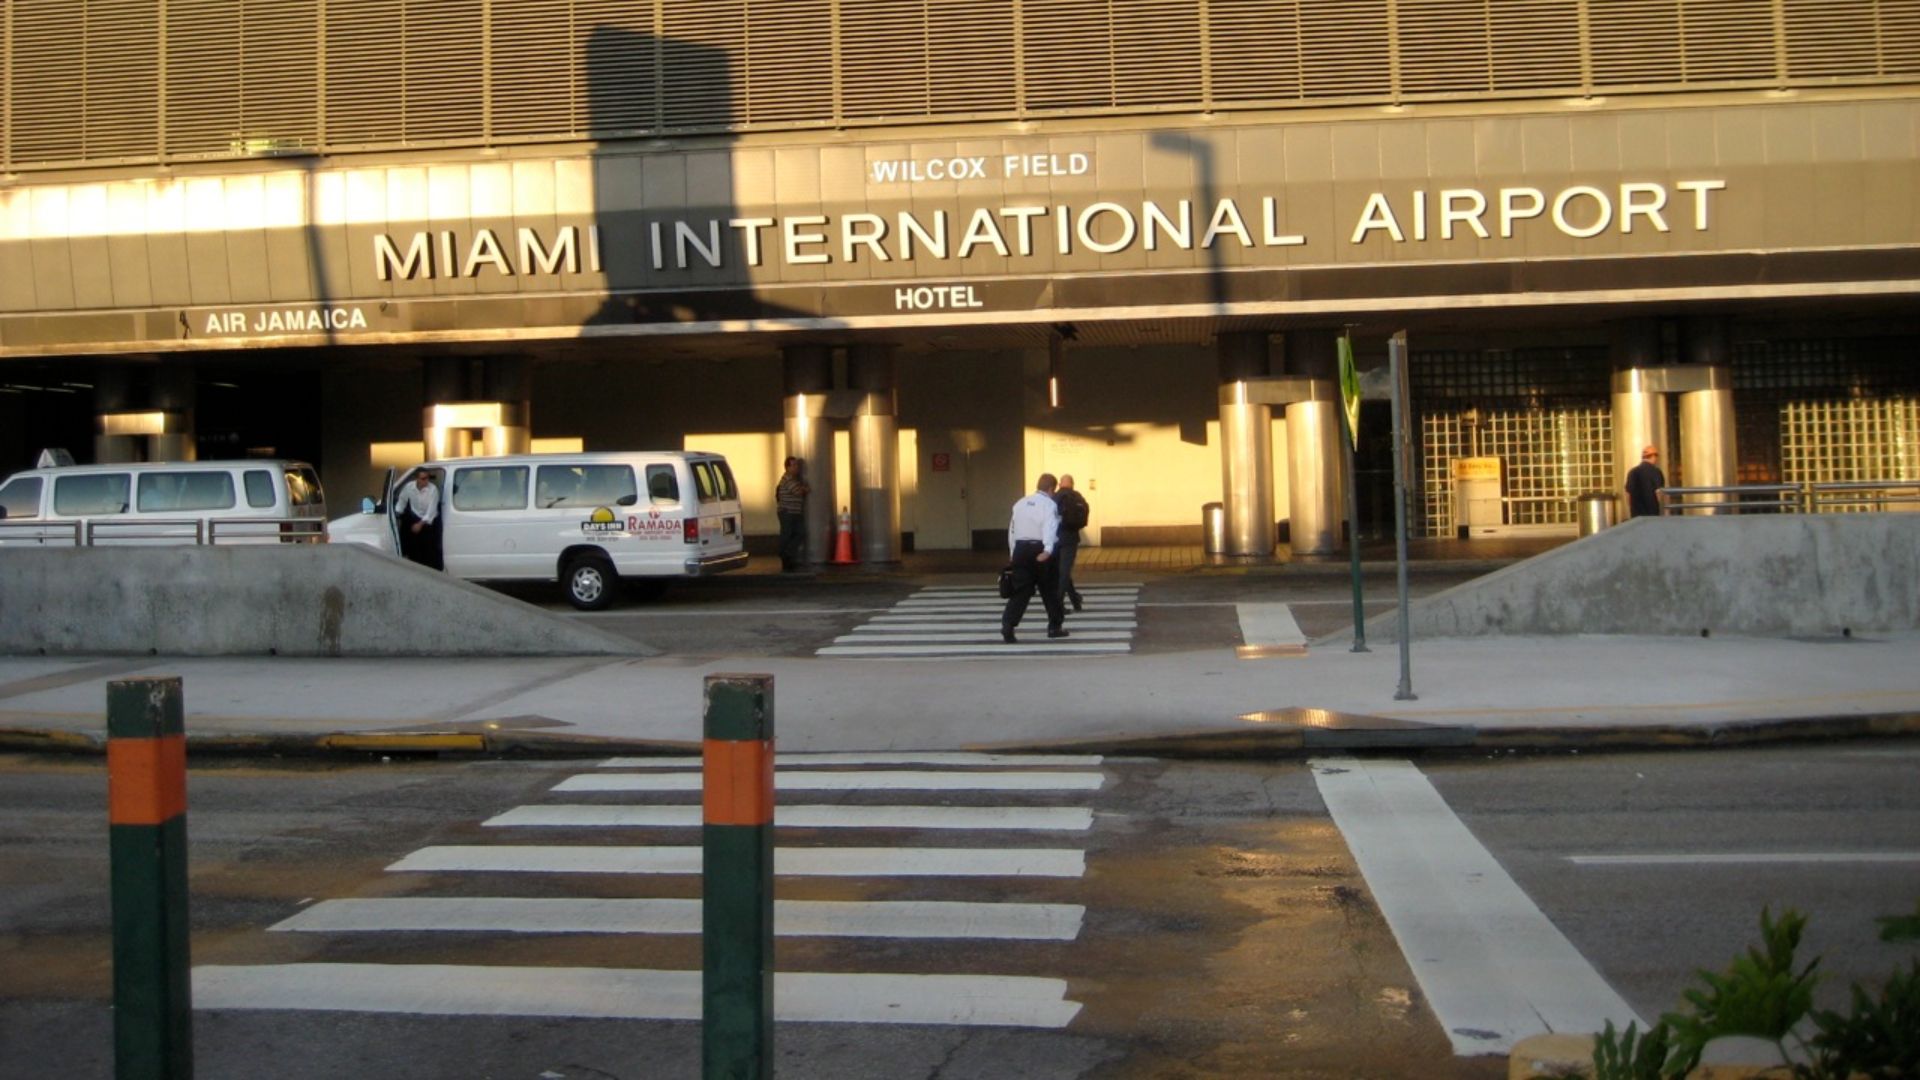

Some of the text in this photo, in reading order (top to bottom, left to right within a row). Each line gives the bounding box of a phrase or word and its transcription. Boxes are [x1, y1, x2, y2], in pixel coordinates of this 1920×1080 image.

[871, 153, 1088, 183] WILCOX FIELD
[373, 180, 1727, 281] MIAMI INTERNATIONAL AIRPORT
[895, 286, 983, 310] HOTEL
[206, 308, 368, 334] AIR JAMAICA
[583, 522, 622, 531] DAYS INN
[628, 516, 682, 530] RAMADA
